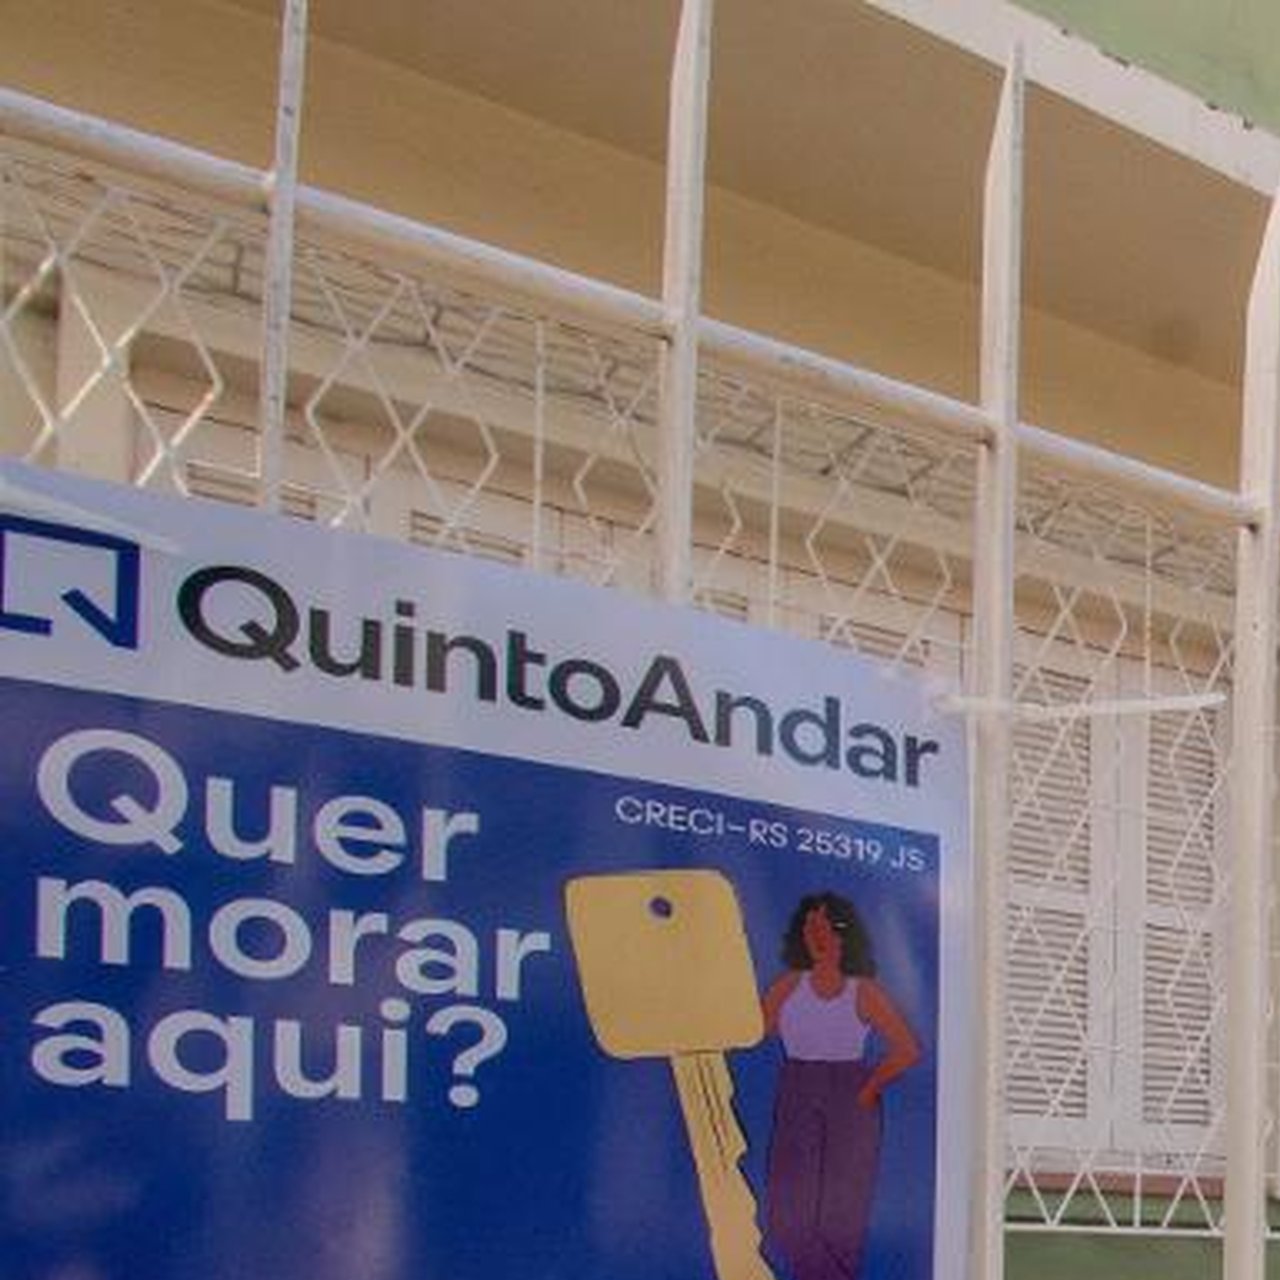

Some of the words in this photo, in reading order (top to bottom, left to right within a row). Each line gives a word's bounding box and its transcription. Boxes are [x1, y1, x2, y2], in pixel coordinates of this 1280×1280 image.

[175, 565, 939, 788] QuintoAndar
[36, 728, 480, 882] Quer
[795, 827, 883, 862] 25319
[890, 847, 926, 873] JS
[36, 879, 552, 1000] morar
[30, 998, 510, 1122] aqui?
